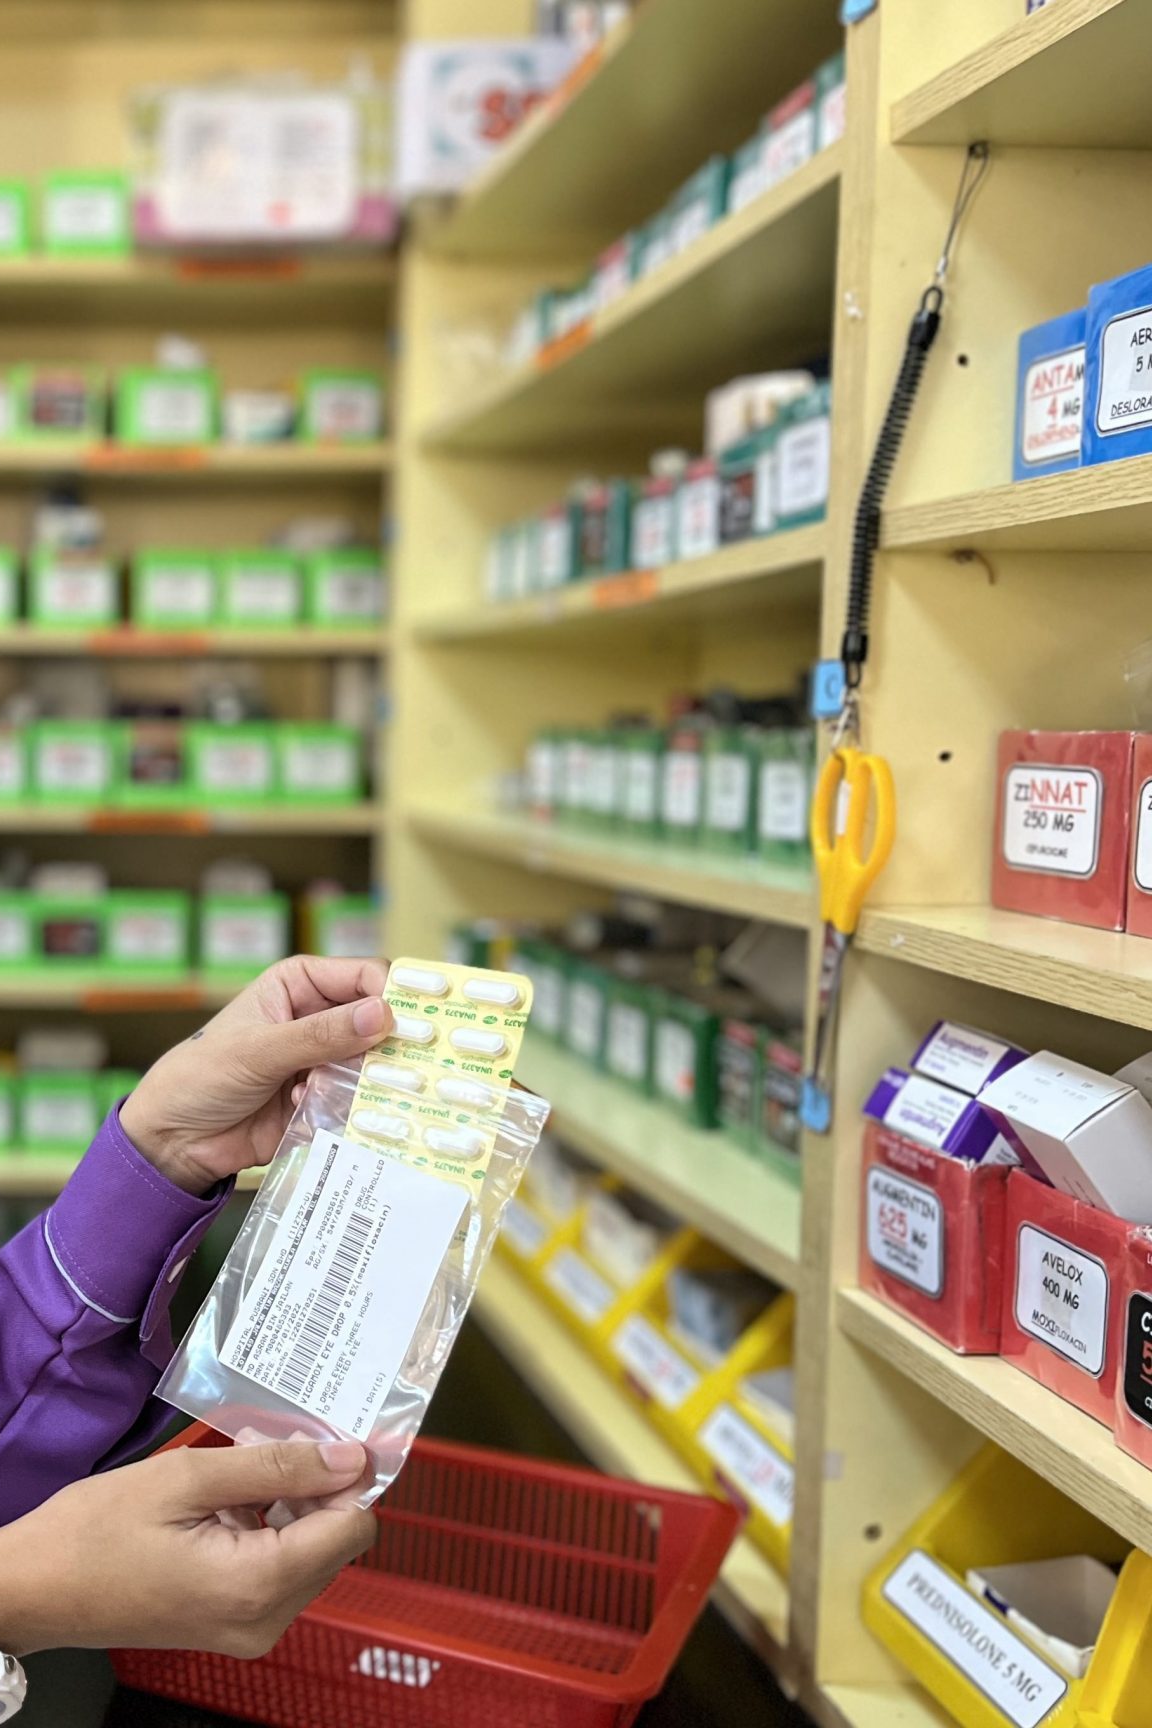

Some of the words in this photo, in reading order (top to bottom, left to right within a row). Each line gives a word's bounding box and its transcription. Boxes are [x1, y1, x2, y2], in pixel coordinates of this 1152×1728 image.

[1136, 356, 1144, 373] 5
[1047, 397, 1059, 422] 4
[1062, 398, 1081, 418] MG
[1014, 778, 1088, 805] ZINNAT
[1023, 811, 1048, 830] 250
[1052, 814, 1074, 832] MG
[445, 1008, 477, 1021] UNA375
[461, 1062, 493, 1075] UNA375
[359, 1158, 385, 1210] CONTROLLED
[434, 1161, 466, 1175] UNA375
[353, 1185, 368, 1207] DRUG
[367, 1197, 378, 1212] (1)
[872, 1177, 936, 1222] AUGMENTIN
[879, 1203, 908, 1241] 625
[911, 1230, 928, 1250] MG
[1041, 1251, 1084, 1287] AVELOX
[1042, 1275, 1060, 1299] 400
[1063, 1290, 1080, 1310] MG
[229, 1324, 252, 1366] HOSPITAL
[266, 1266, 279, 1283] SDN
[245, 1362, 254, 1374] MD
[252, 1333, 269, 1360] ASRAN
[265, 1313, 278, 1331] BIN
[274, 1279, 293, 1311] JAILAN
[273, 1302, 301, 1353] 27/01/2022
[1031, 1309, 1087, 1355] MOXIFLOXACIN
[299, 1362, 324, 1405] VIGAMOX
[320, 1339, 334, 1359] EYE
[330, 1311, 347, 1337] DROP
[319, 1380, 333, 1403] DROP
[330, 1350, 347, 1378] EVERY
[344, 1320, 361, 1347] THREE
[357, 1290, 374, 1318] HOURS
[321, 1403, 331, 1415] TO
[328, 1358, 352, 1400] INFECTED
[351, 1415, 364, 1434] FOR
[906, 1572, 1007, 1671] PREDNISOLONE
[1002, 1662, 1016, 1679] 5
[1011, 1670, 1042, 1703] MG
